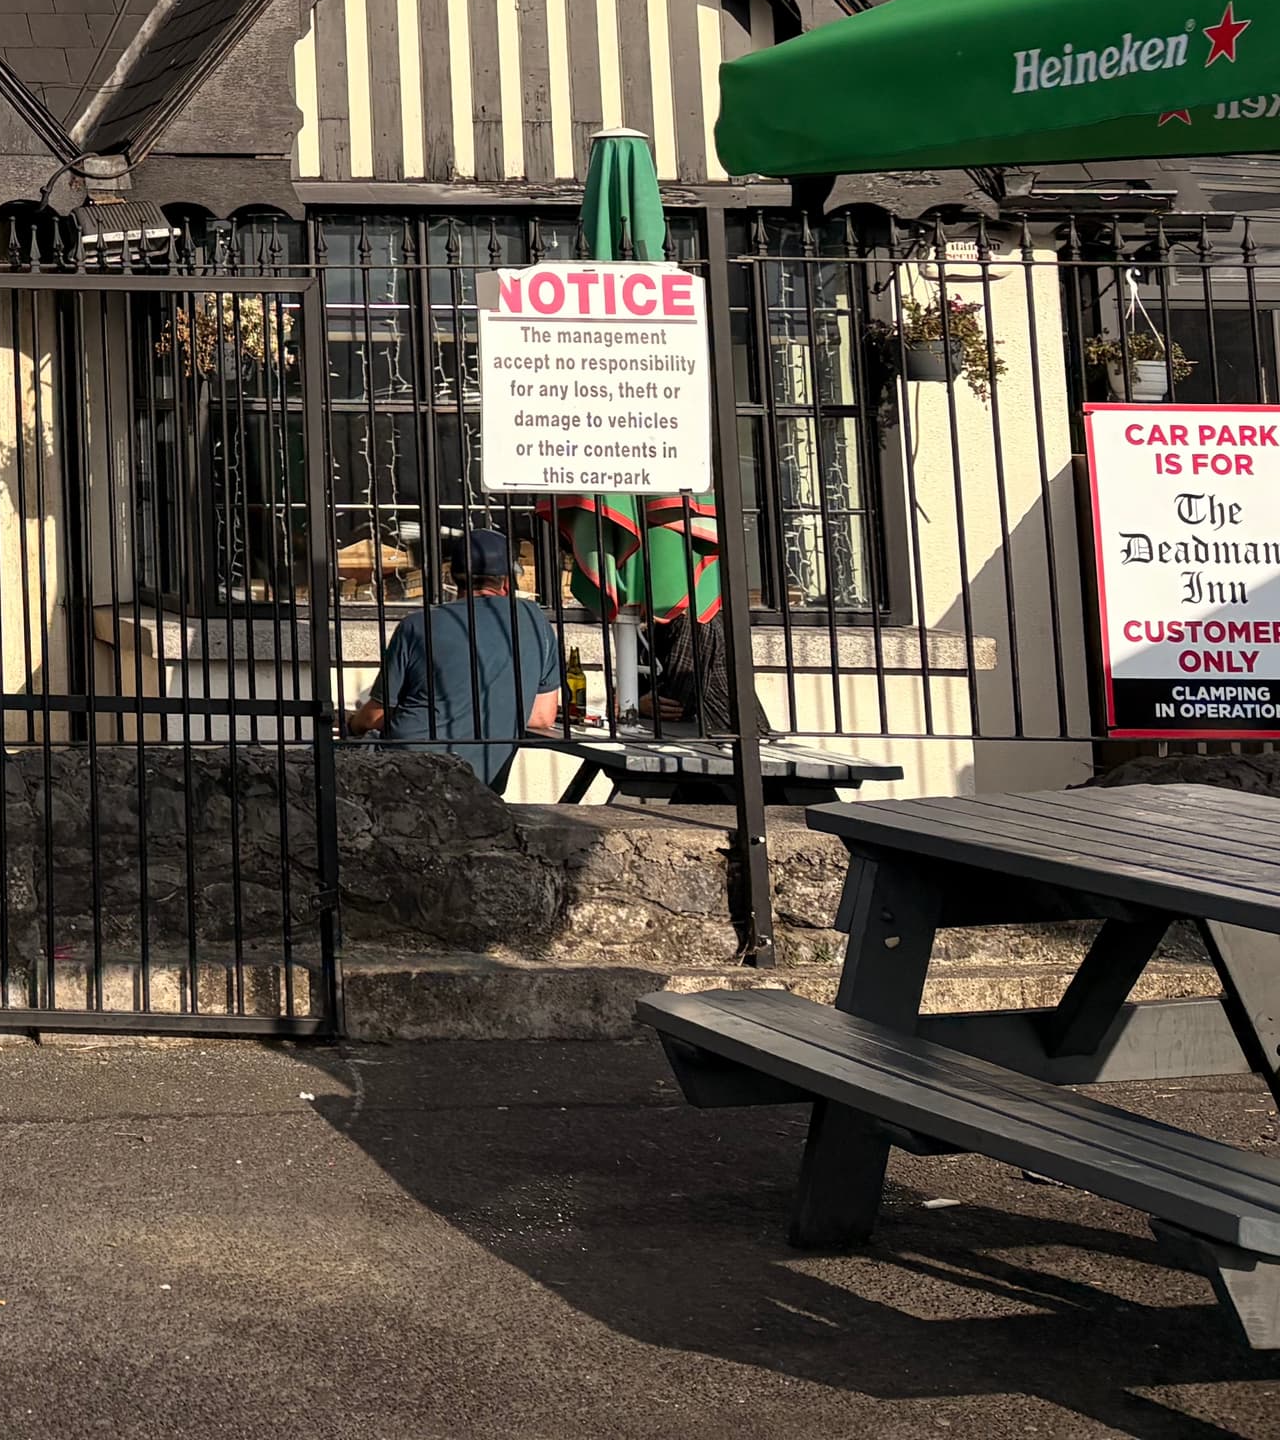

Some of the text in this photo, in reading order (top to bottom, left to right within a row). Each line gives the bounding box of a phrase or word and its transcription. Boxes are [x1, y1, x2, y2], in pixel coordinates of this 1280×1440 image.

[1012, 33, 1188, 94] Heineken
[490, 271, 696, 316] NOTICE
[521, 327, 666, 347] The management
[494, 354, 695, 375] accept no responsibility
[511, 380, 680, 401] for any loss, theft or
[515, 410, 678, 431] damage to vehicles
[1125, 424, 1278, 446] CAR PARK
[516, 440, 677, 458] or their contents in
[1156, 454, 1252, 475] IS FOR
[543, 467, 650, 487] this car-park
[1174, 493, 1243, 530] The
[1181, 571, 1249, 604] Inn
[1179, 650, 1259, 672] ONLY
[1173, 687, 1270, 700] CLAMPING
[1155, 703, 1176, 718] IN
